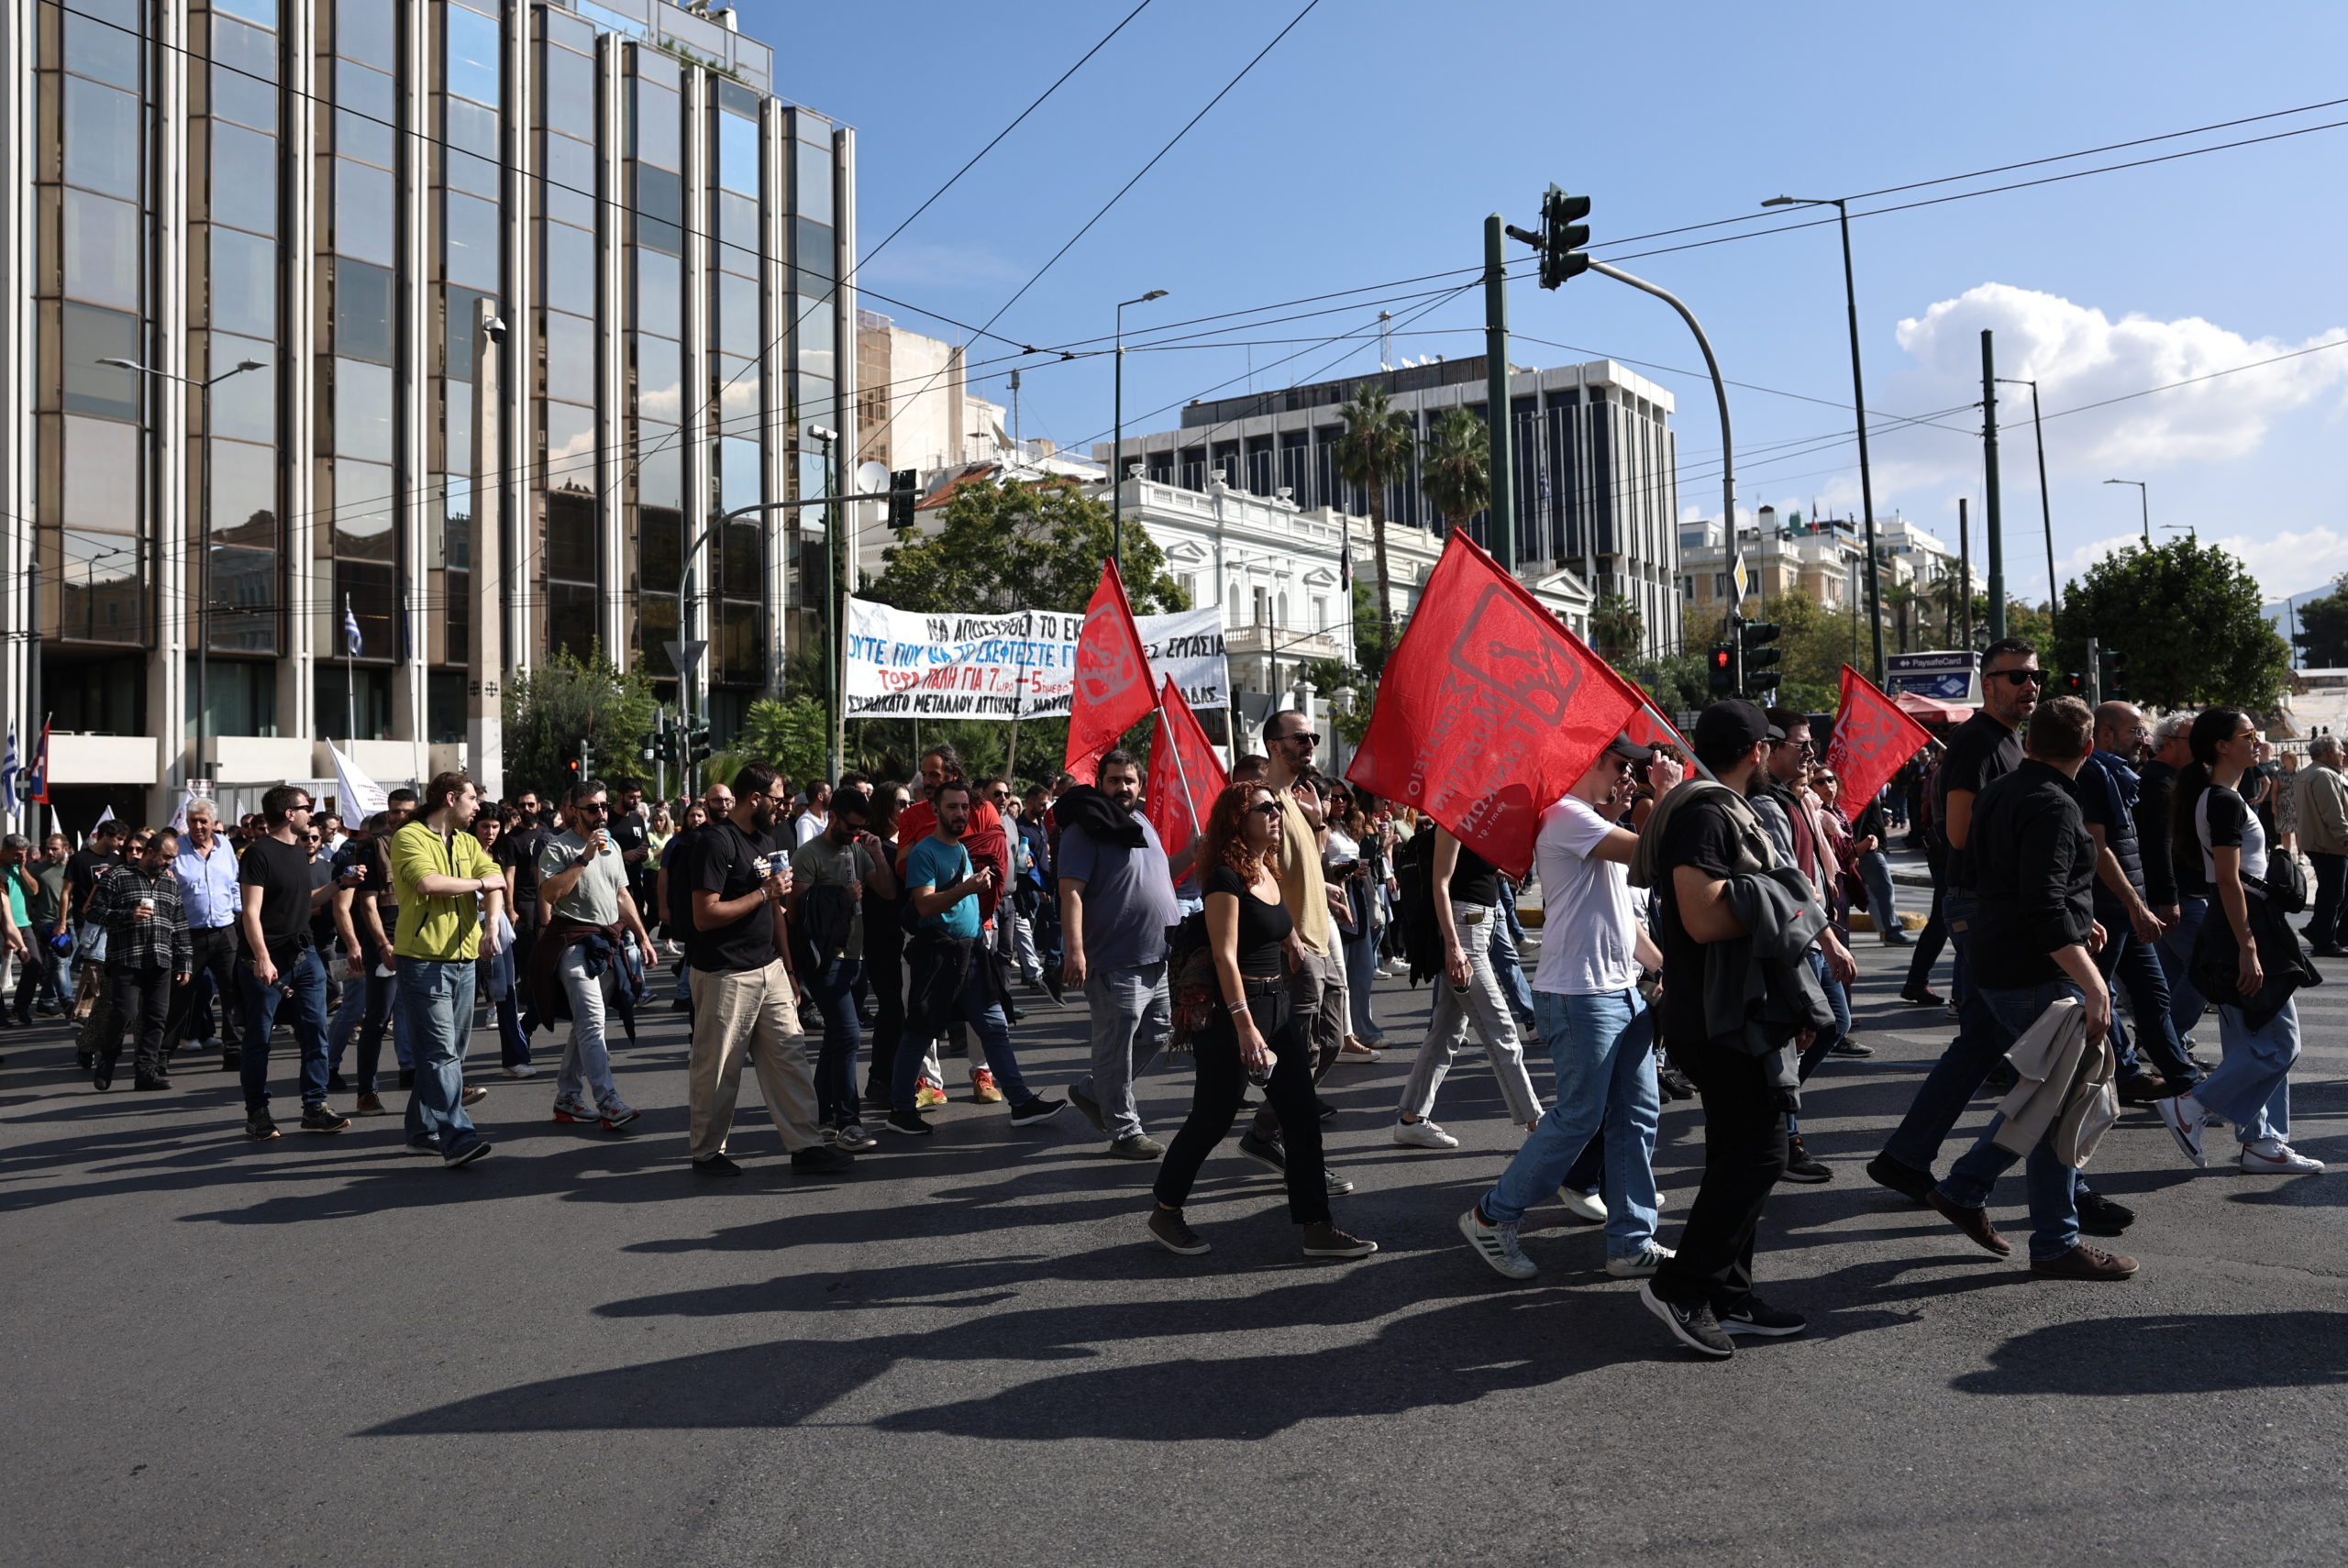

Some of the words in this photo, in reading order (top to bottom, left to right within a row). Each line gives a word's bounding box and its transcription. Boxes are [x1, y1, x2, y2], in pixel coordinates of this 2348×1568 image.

[926, 619, 948, 642] ΝΑ
[1040, 615, 1057, 639] ΤΟ
[892, 642, 924, 667] ΠΟΥ
[928, 646, 952, 663] ΝΑ
[1062, 645, 1077, 668] ΓΙ
[1912, 657, 1962, 668] PaysafeCard
[922, 667, 958, 690] ΠΑΛΗ
[961, 667, 982, 690] ΓΙΑ
[914, 693, 974, 713] ΜΕΤΑΛΛΟΥ
[975, 695, 1022, 714] ΑΤΤΙΚΗΣ
